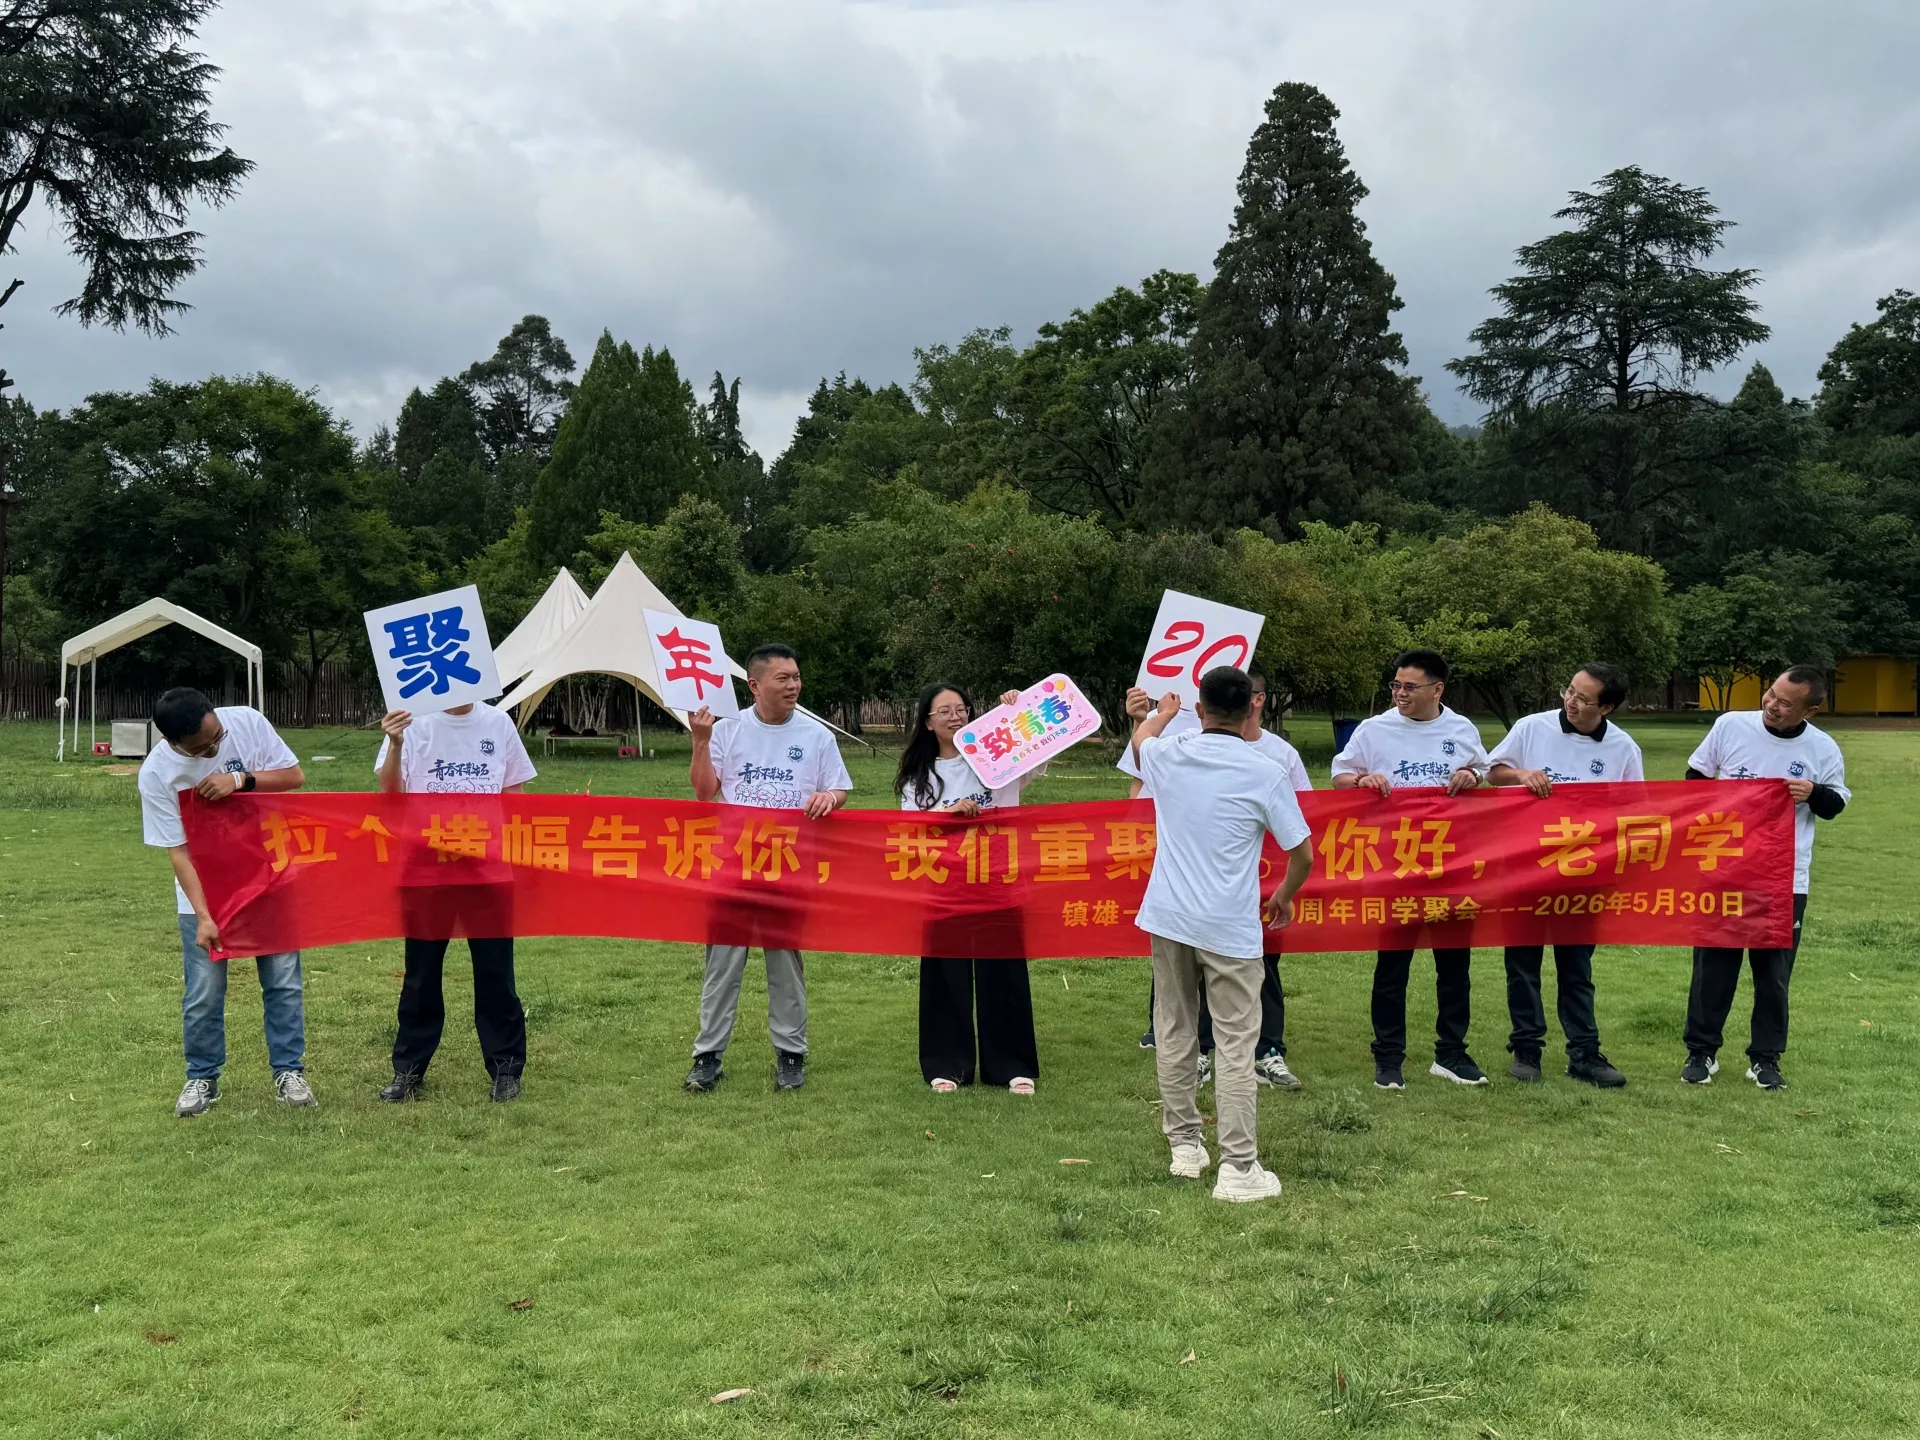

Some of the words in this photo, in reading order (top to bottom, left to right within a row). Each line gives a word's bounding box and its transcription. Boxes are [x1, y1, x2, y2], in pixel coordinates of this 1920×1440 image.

[383, 605, 481, 700] 聚
[656, 625, 725, 701] 年
[1146, 620, 1249, 689] 20
[978, 694, 1072, 762] 致青春
